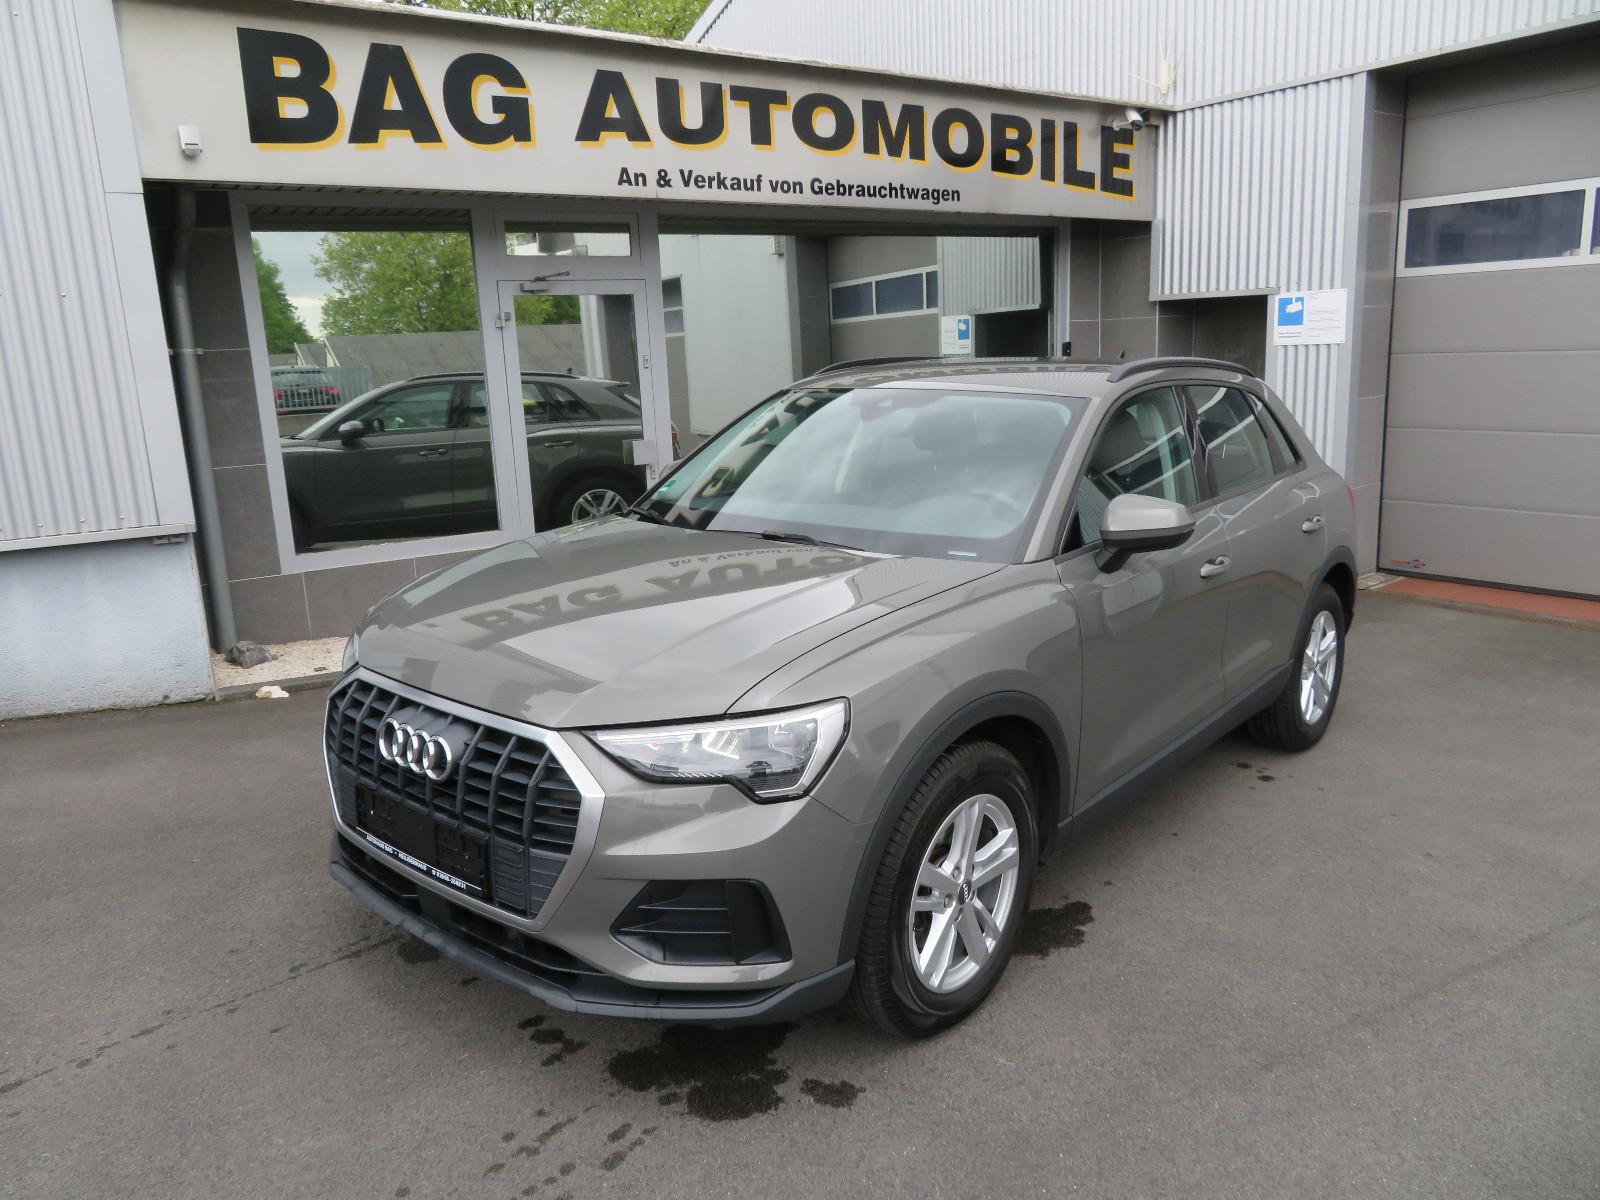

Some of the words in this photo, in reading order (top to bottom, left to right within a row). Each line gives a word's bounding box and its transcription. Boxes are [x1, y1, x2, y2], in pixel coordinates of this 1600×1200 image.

[237, 27, 534, 149] BAG
[575, 69, 1135, 199] AUTOMOBILE
[618, 167, 648, 187] An
[656, 169, 672, 188] &
[679, 169, 762, 193] Verkauf
[769, 179, 804, 195] von
[810, 178, 961, 205] Gebrauchtwagen
